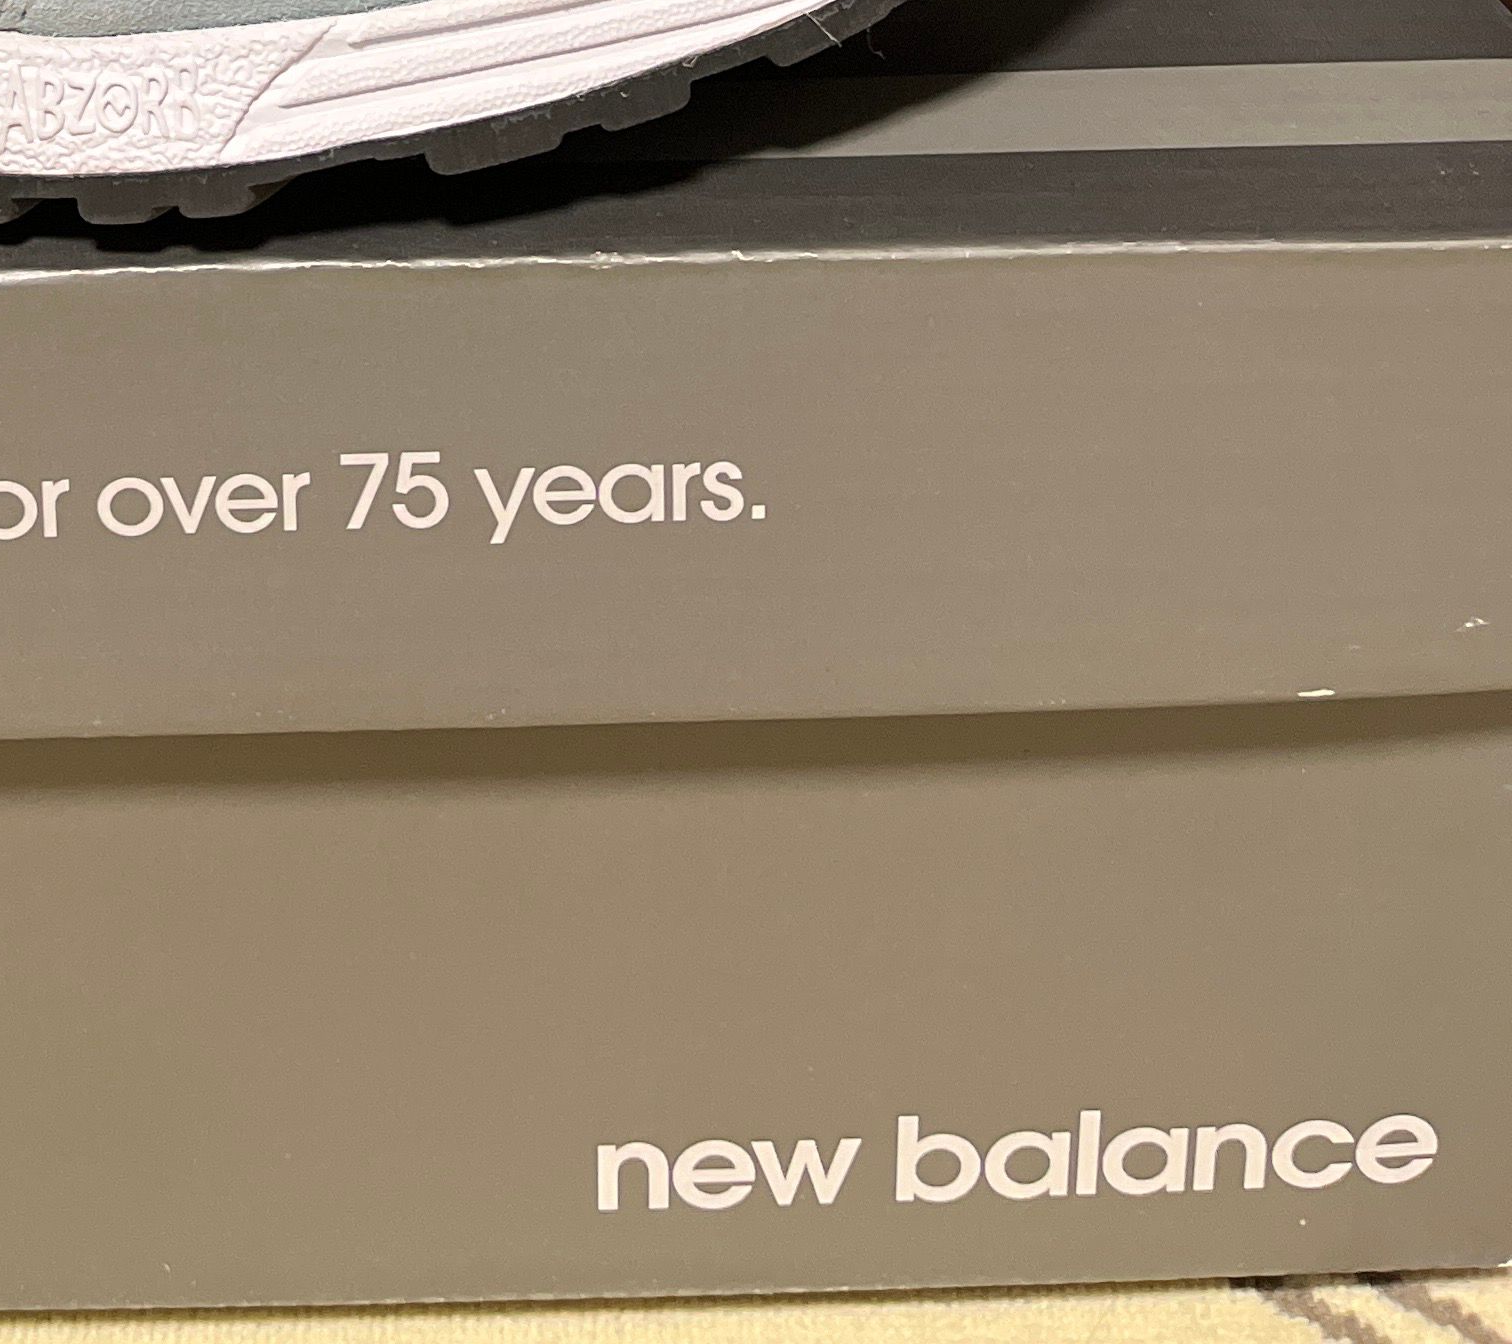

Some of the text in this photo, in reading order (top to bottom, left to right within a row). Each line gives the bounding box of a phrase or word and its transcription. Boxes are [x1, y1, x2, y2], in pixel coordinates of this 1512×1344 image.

[96, 471, 311, 537] over
[339, 451, 449, 530] 75
[473, 461, 766, 545] years.
[597, 1110, 1438, 1211] new balance
